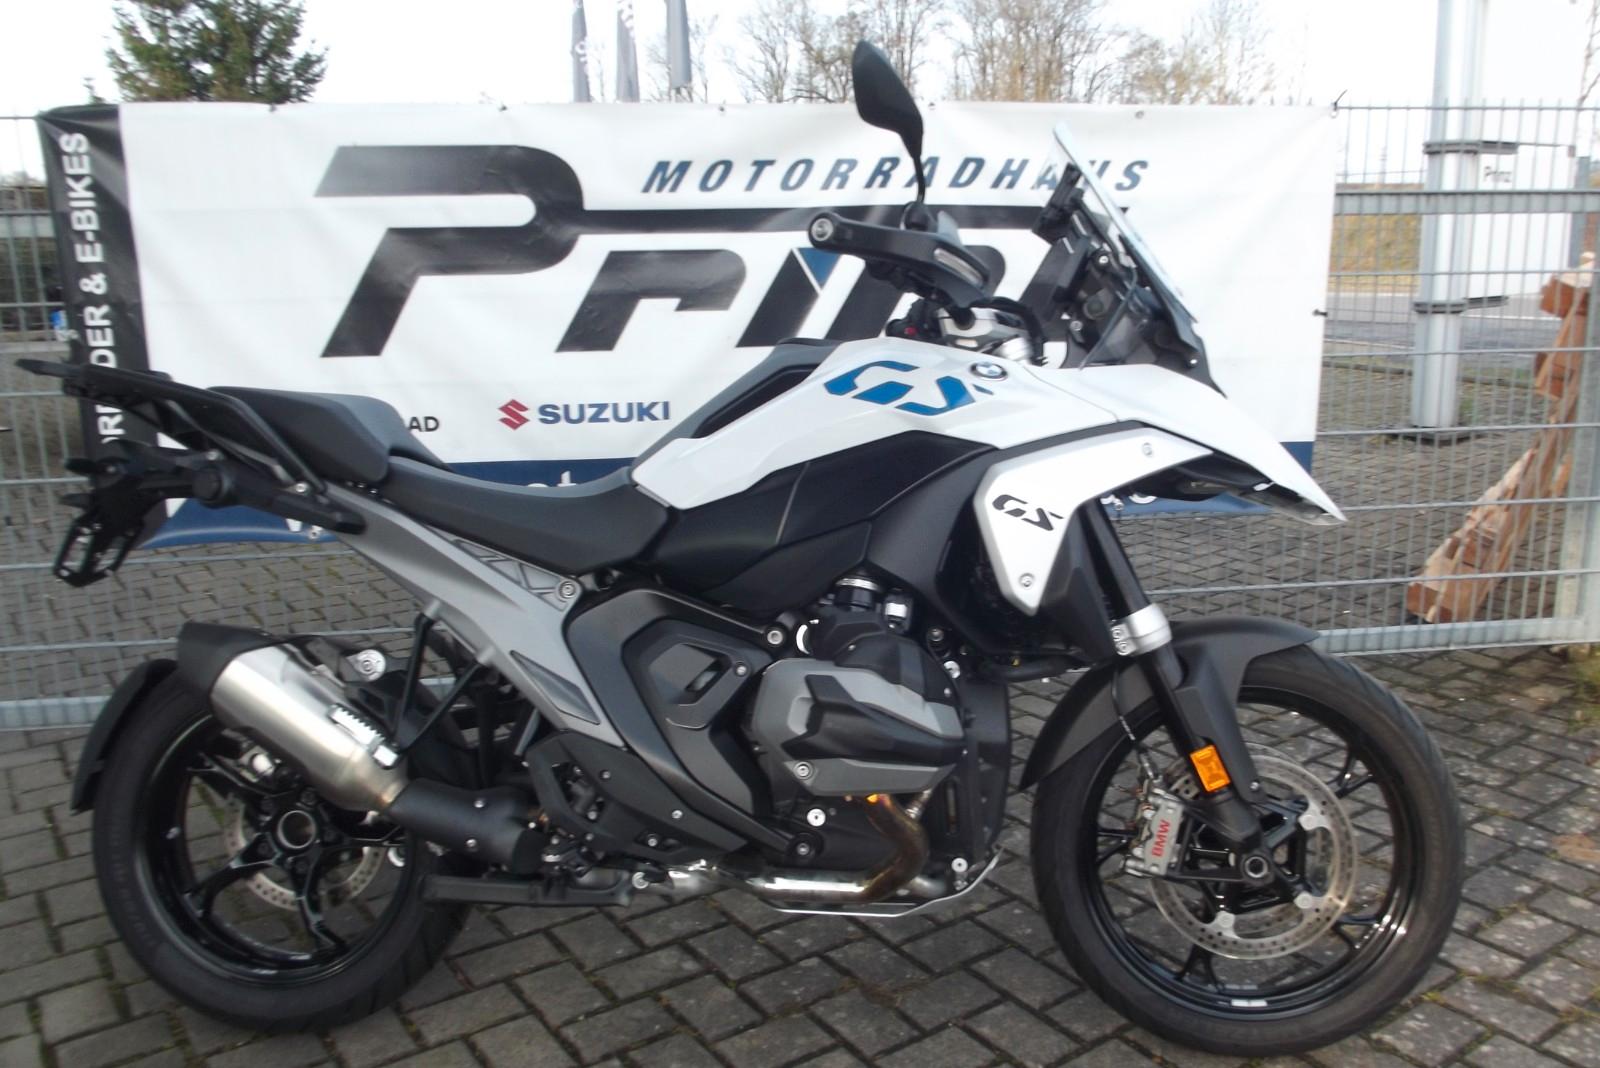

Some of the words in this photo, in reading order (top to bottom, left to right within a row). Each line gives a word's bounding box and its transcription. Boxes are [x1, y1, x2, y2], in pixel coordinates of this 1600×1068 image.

[59, 132, 105, 263] E-BIKES
[79, 273, 107, 295] &
[538, 401, 670, 424] SUZUKI
[1152, 819, 1171, 857] BMW
